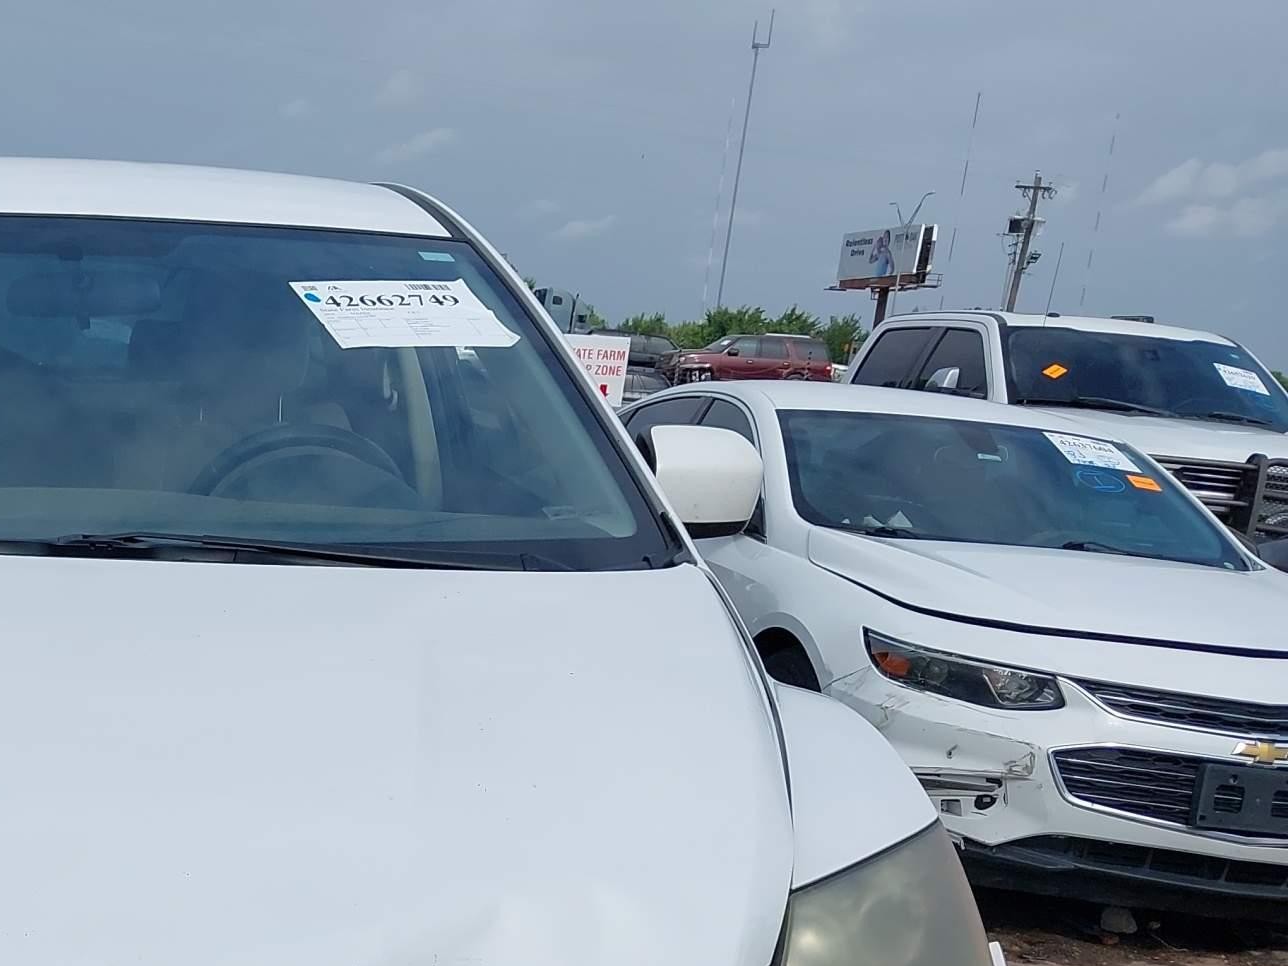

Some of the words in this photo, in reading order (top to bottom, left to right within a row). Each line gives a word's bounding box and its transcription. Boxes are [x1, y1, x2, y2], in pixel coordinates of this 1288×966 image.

[325, 294, 460, 307] 42662749
[573, 348, 594, 360] ATE
[597, 349, 627, 361] FARM
[594, 365, 623, 376] ZONE
